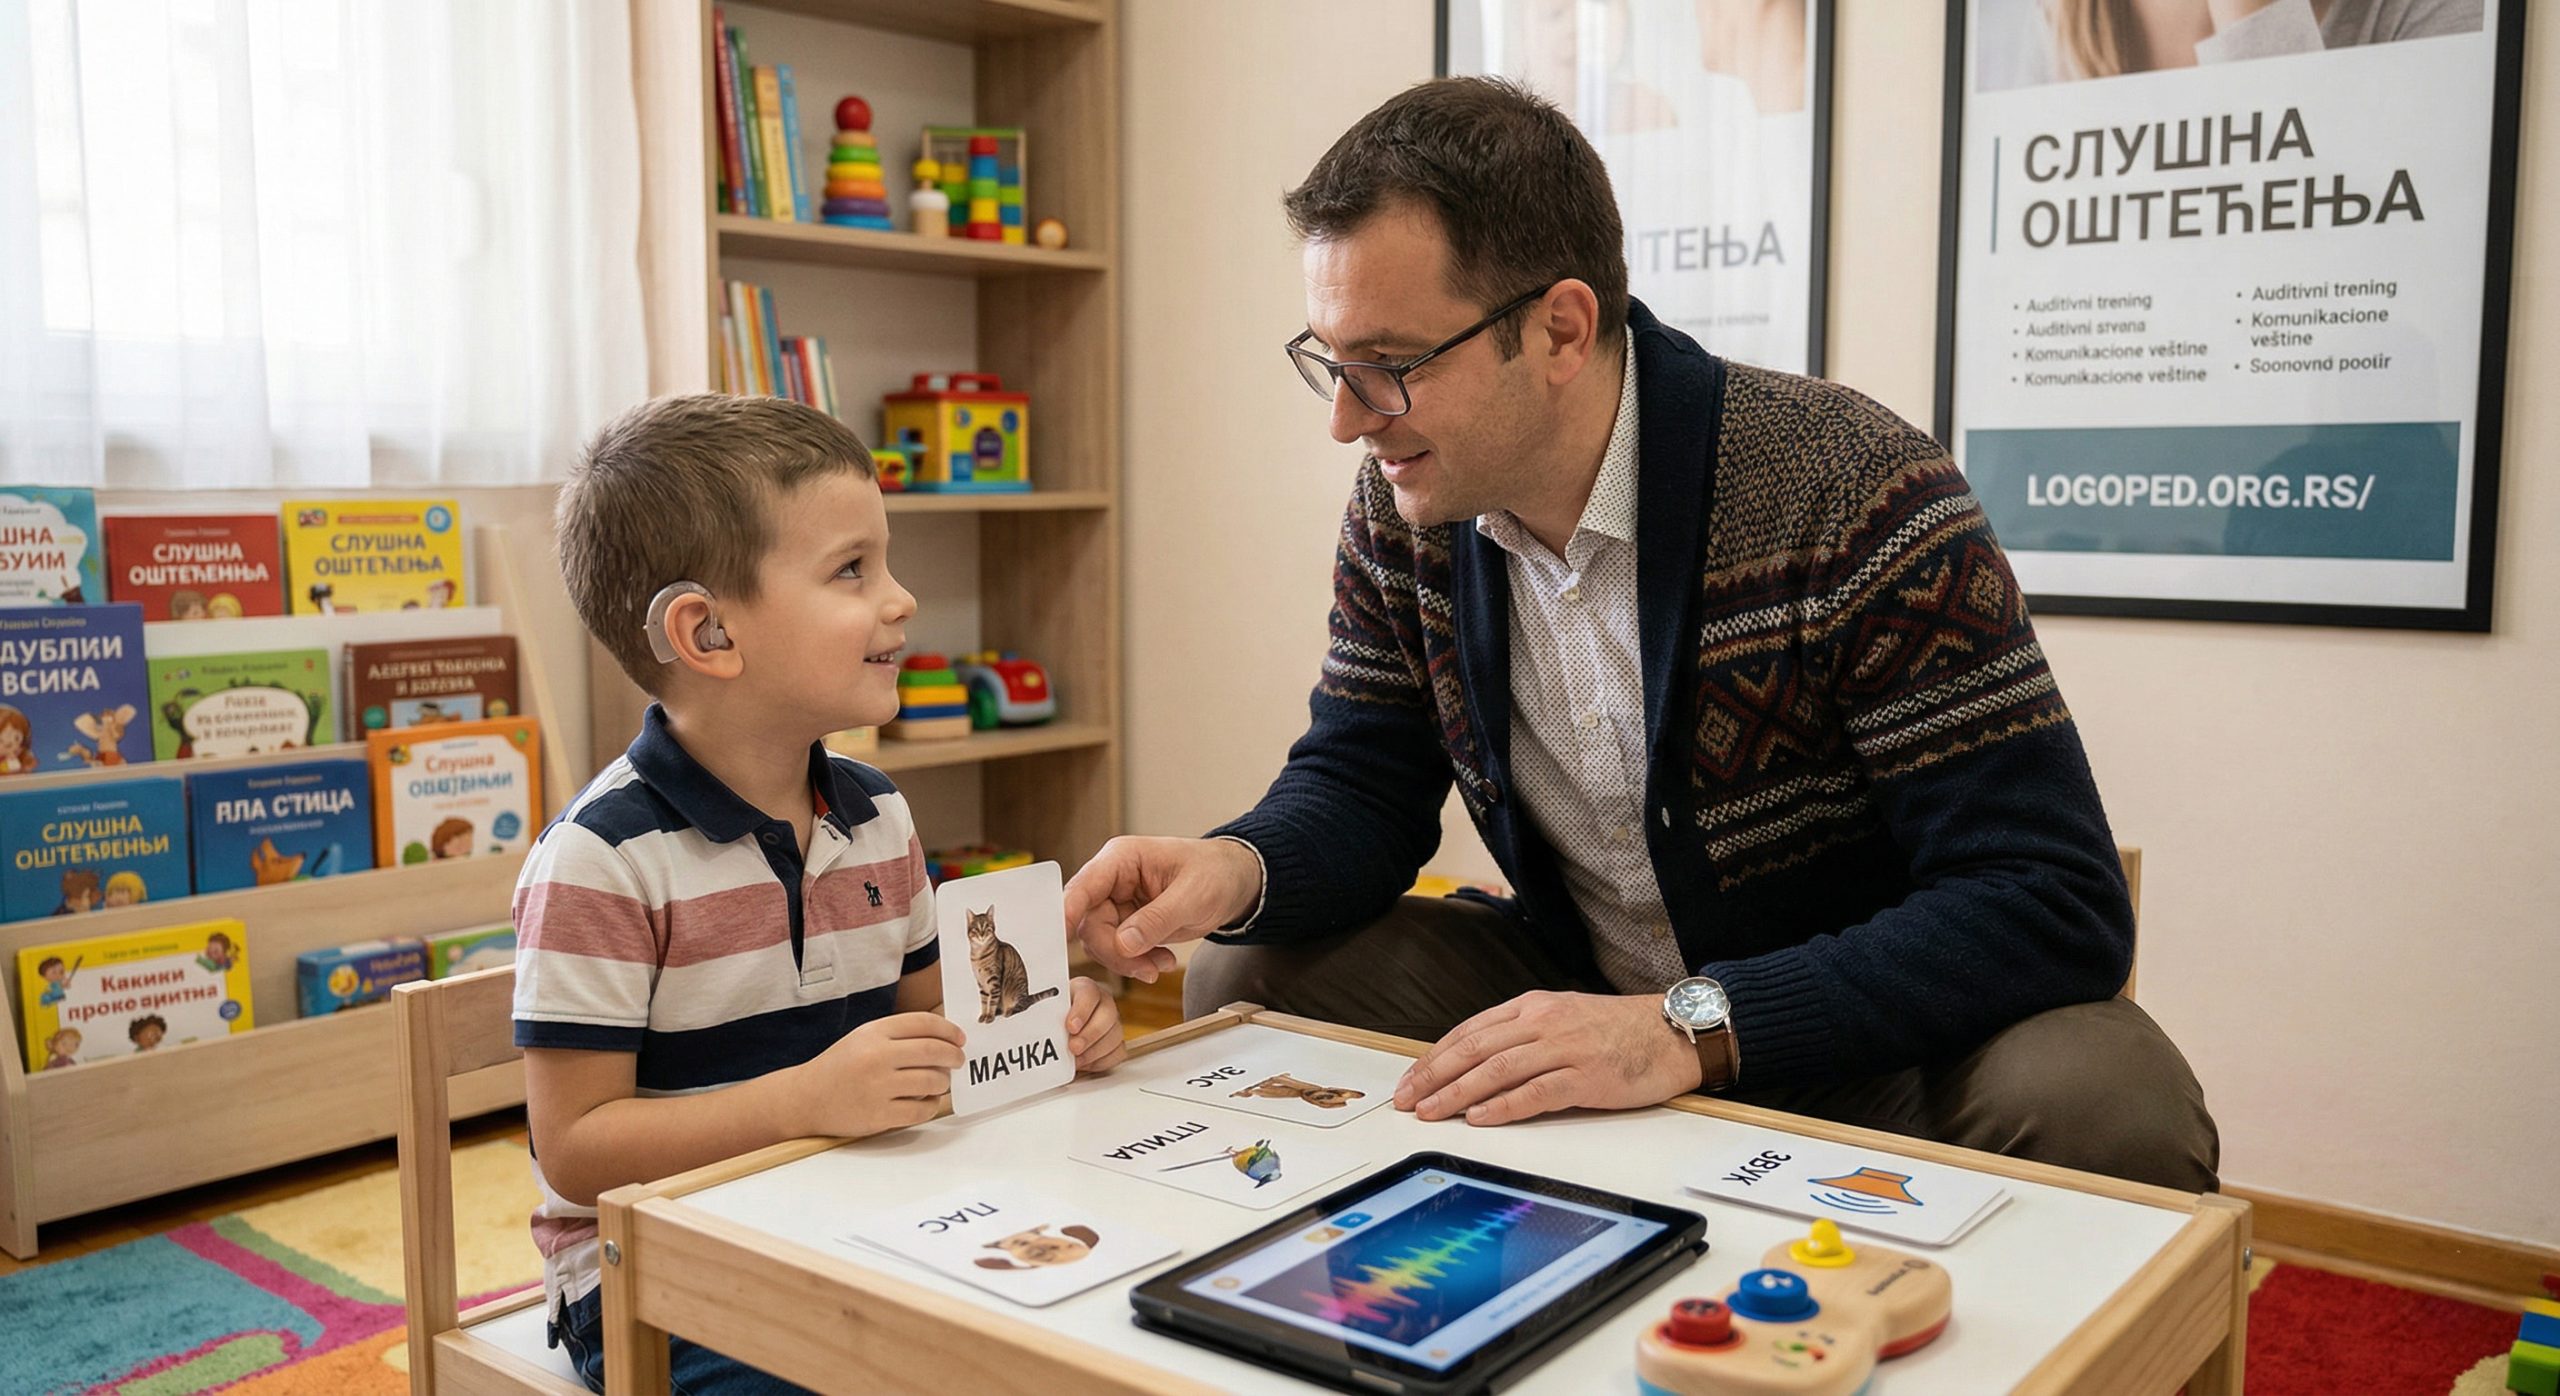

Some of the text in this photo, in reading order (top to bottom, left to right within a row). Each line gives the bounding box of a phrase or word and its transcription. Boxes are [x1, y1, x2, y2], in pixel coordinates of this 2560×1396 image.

[2024, 107, 2315, 183] СЛУШНА
[2022, 168, 2425, 249] ОШТЕЋЕЊА
[2252, 279, 2398, 301] Auditivni trening
[2026, 293, 2153, 313] Auditivni trening
[2026, 320, 2092, 337] Auditivni
[2251, 307, 2389, 328] Komunikacione
[2250, 331, 2313, 347] veštine
[2025, 340, 2208, 363] Komunikacione veštine
[2024, 366, 2207, 386] Komunikacione veštine
[2027, 474, 2376, 511] LOGOPED.ORG.RS/
[152, 541, 244, 563] СЛУШНА
[331, 533, 427, 553] СЛУШНА
[2, 665, 101, 696] ВСИКА
[41, 814, 144, 844] СЛУШНА
[968, 1037, 1060, 1086] МАЧКА
[1186, 1065, 1247, 1088] ЗАС
[1103, 1120, 1210, 1161] ПТИЦА
[1721, 1149, 1792, 1187] ЗВУК
[917, 1201, 1000, 1234] ПАС
